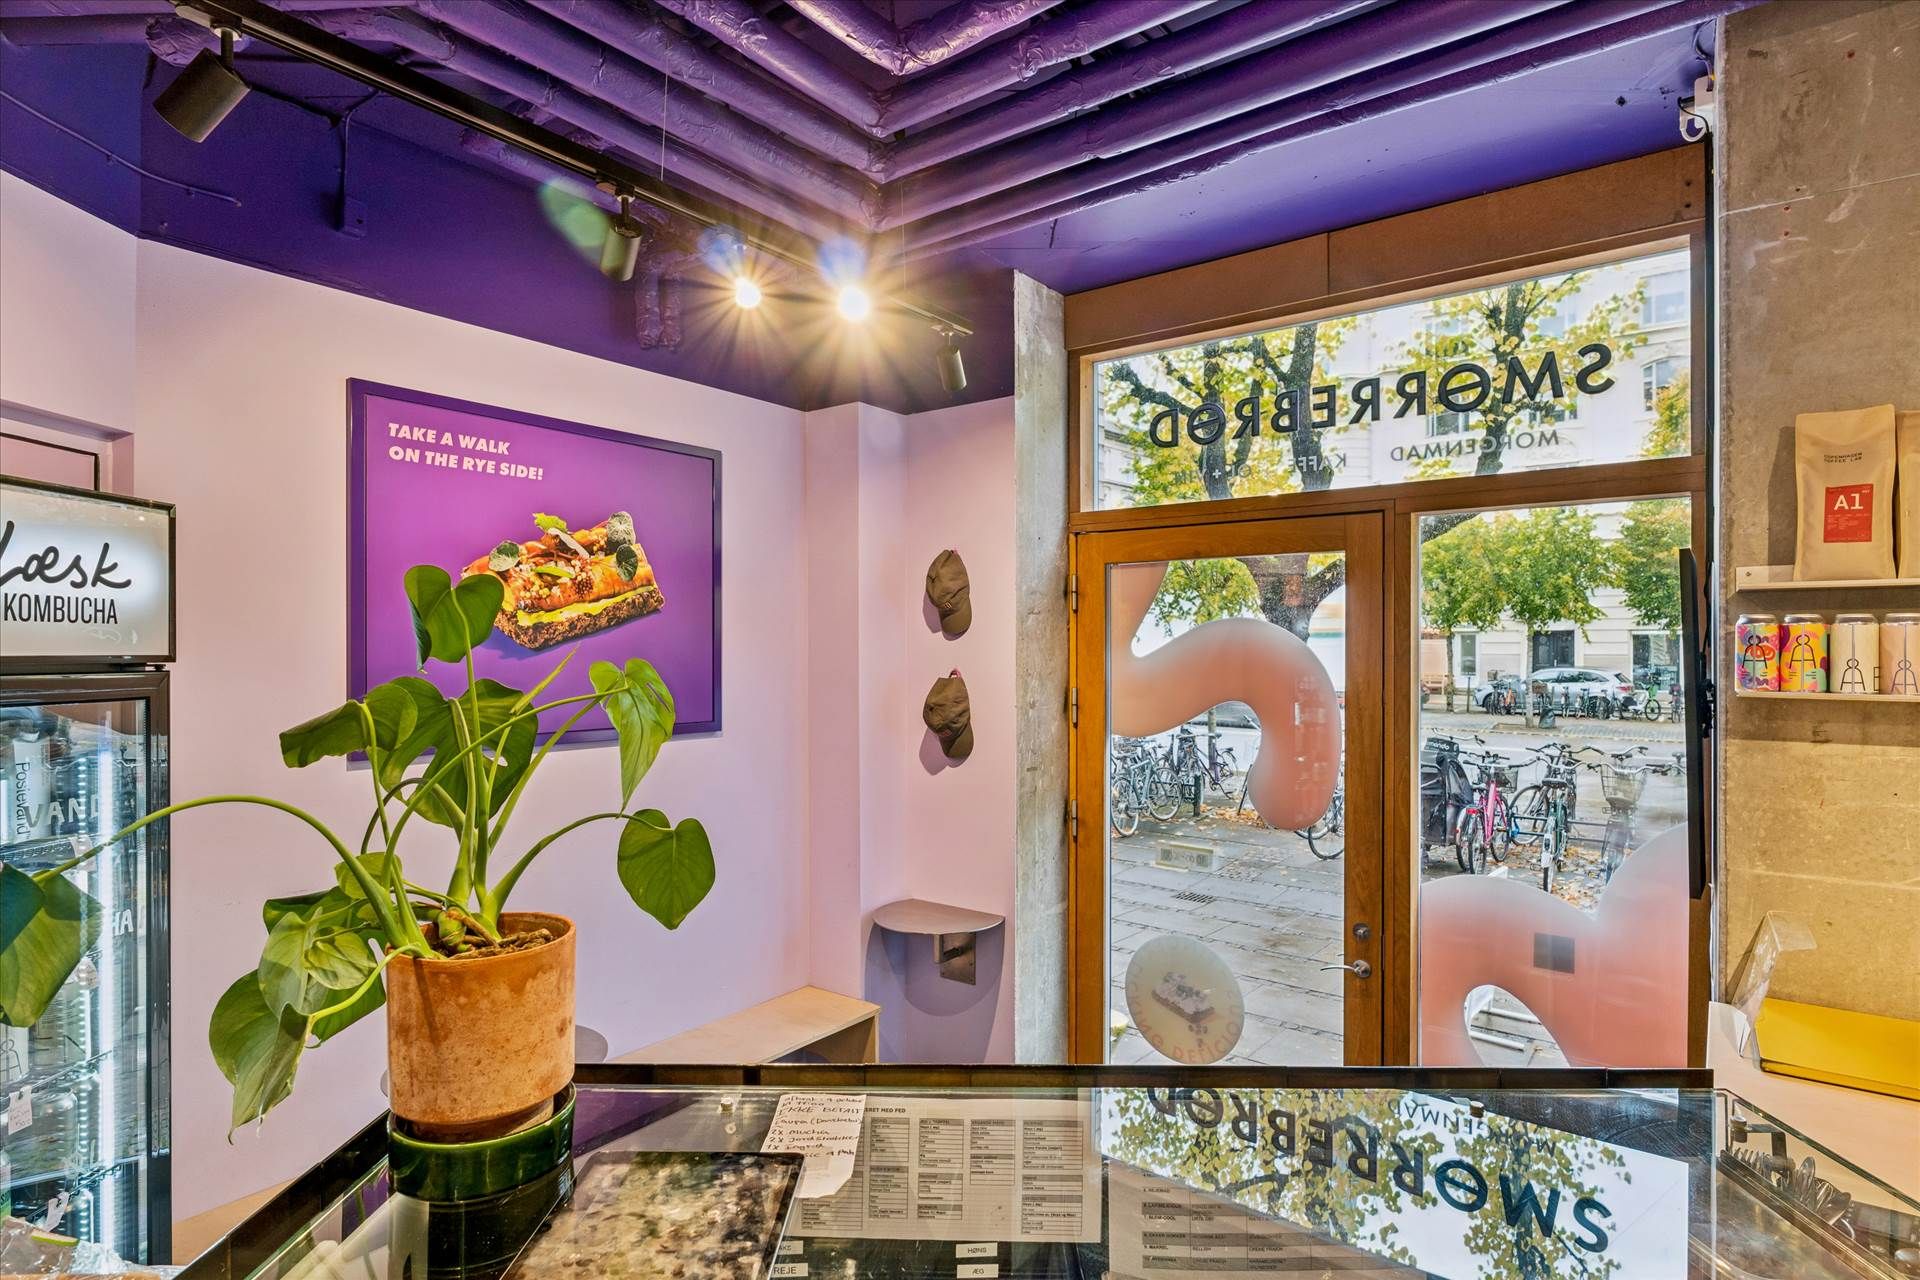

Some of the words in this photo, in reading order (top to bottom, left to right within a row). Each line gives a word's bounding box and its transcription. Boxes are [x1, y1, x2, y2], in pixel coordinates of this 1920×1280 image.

[388, 422, 437, 444] TAKE
[440, 432, 454, 447] A
[458, 434, 511, 455] WALK
[388, 445, 420, 463] ON
[424, 451, 459, 469] THE
[462, 456, 496, 474] RYE
[499, 462, 544, 481] SIDE!
[1834, 493, 1864, 511] A1
[3, 593, 118, 624] KOMBUCHA
[773, 1265, 797, 1275] REJE
